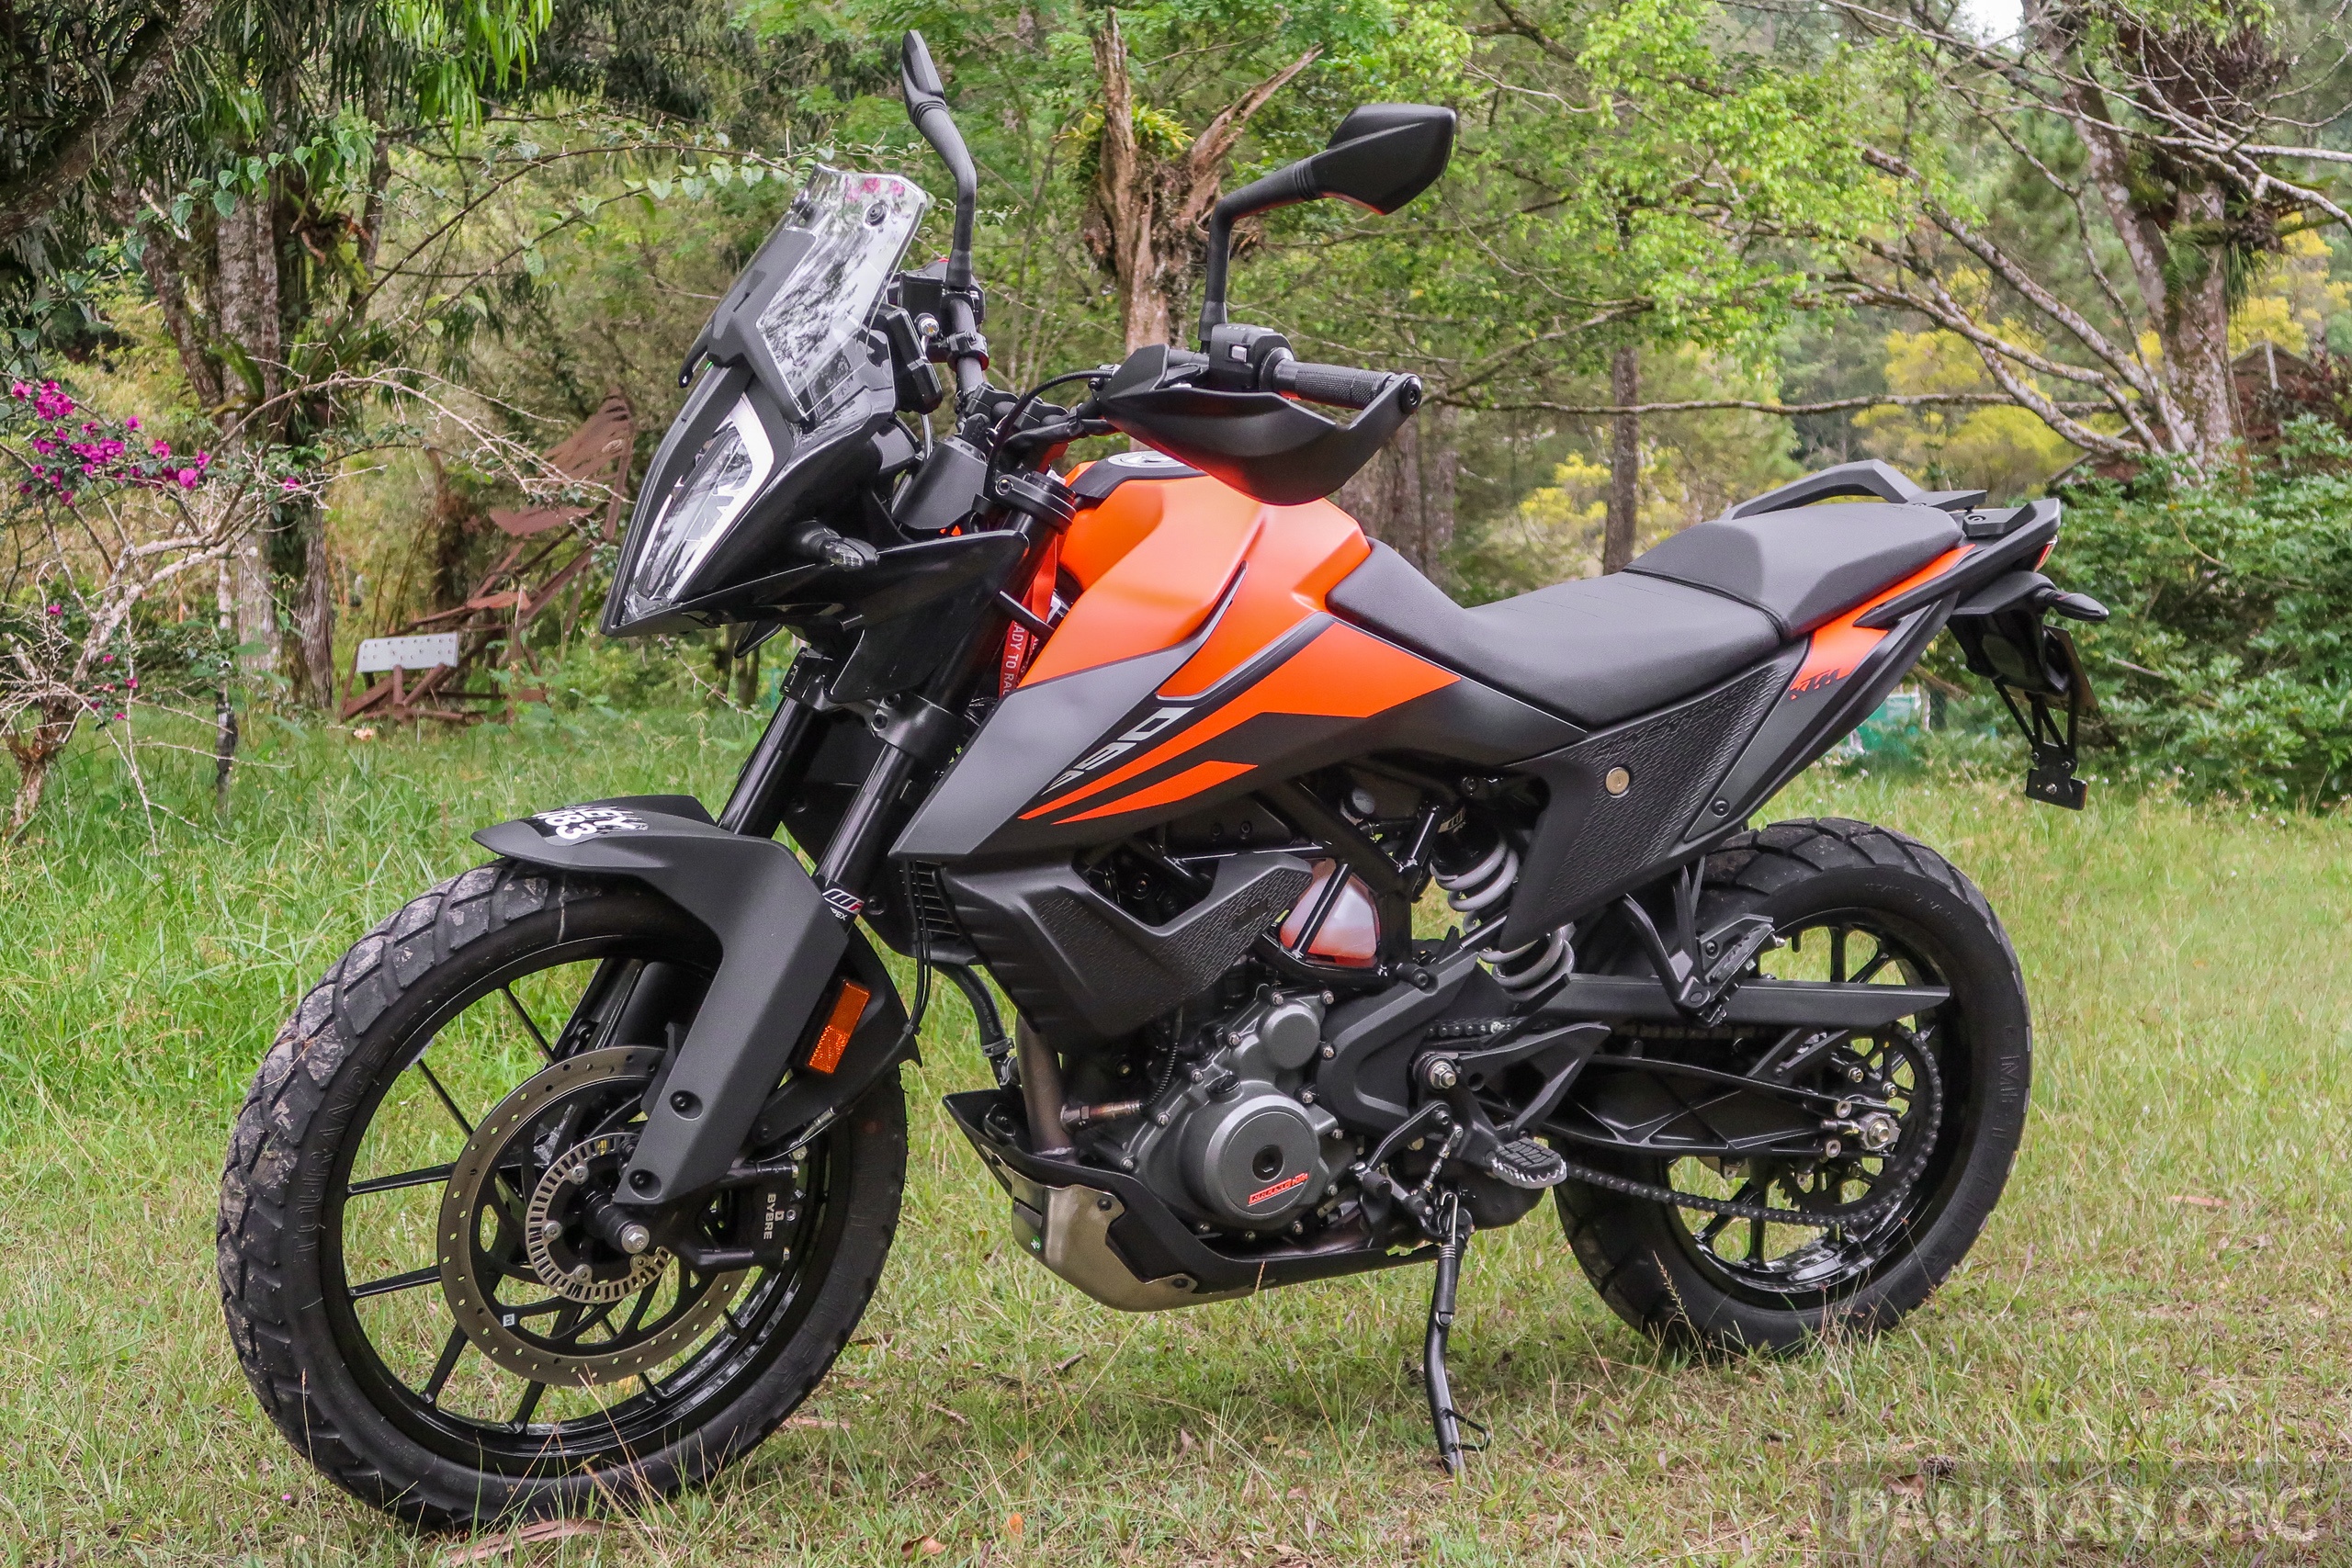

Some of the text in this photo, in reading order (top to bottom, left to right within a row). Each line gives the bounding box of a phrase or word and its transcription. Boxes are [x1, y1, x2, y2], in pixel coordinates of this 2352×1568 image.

[1010, 622, 1026, 652] ADY
[1005, 654, 1019, 669] TO
[763, 1192, 777, 1240] BYBRE
